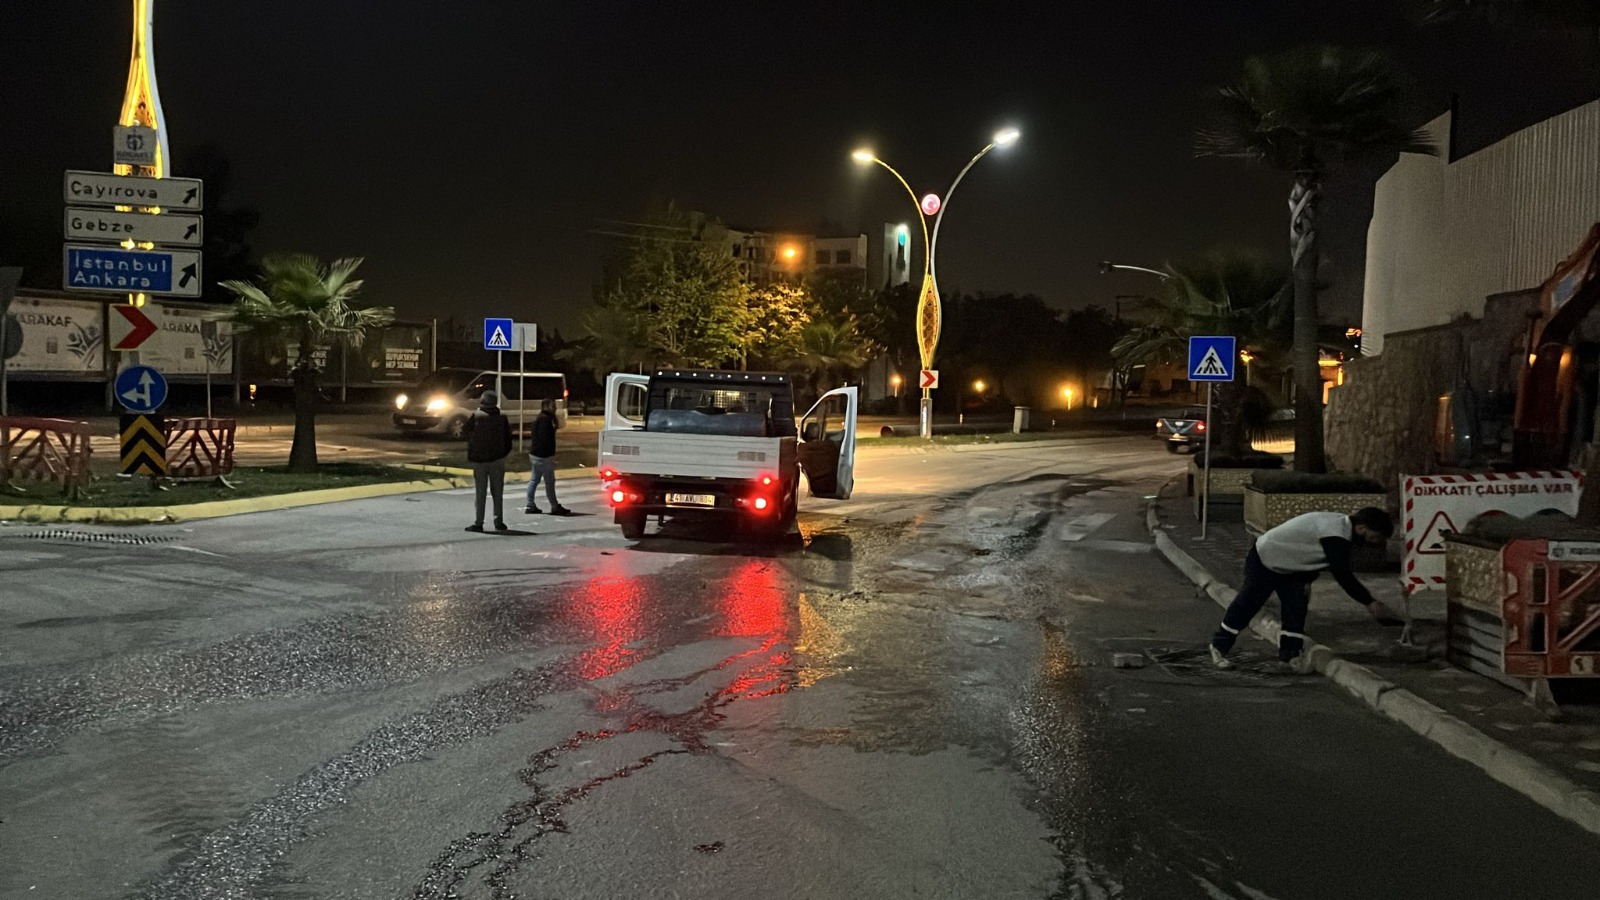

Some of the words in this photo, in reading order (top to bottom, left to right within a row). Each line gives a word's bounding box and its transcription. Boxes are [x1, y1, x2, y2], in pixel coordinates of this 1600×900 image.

[71, 181, 158, 198] Çayırova
[72, 217, 134, 233] Gebze
[74, 271, 150, 287] Ankara
[1544, 483, 1573, 493] VAR
